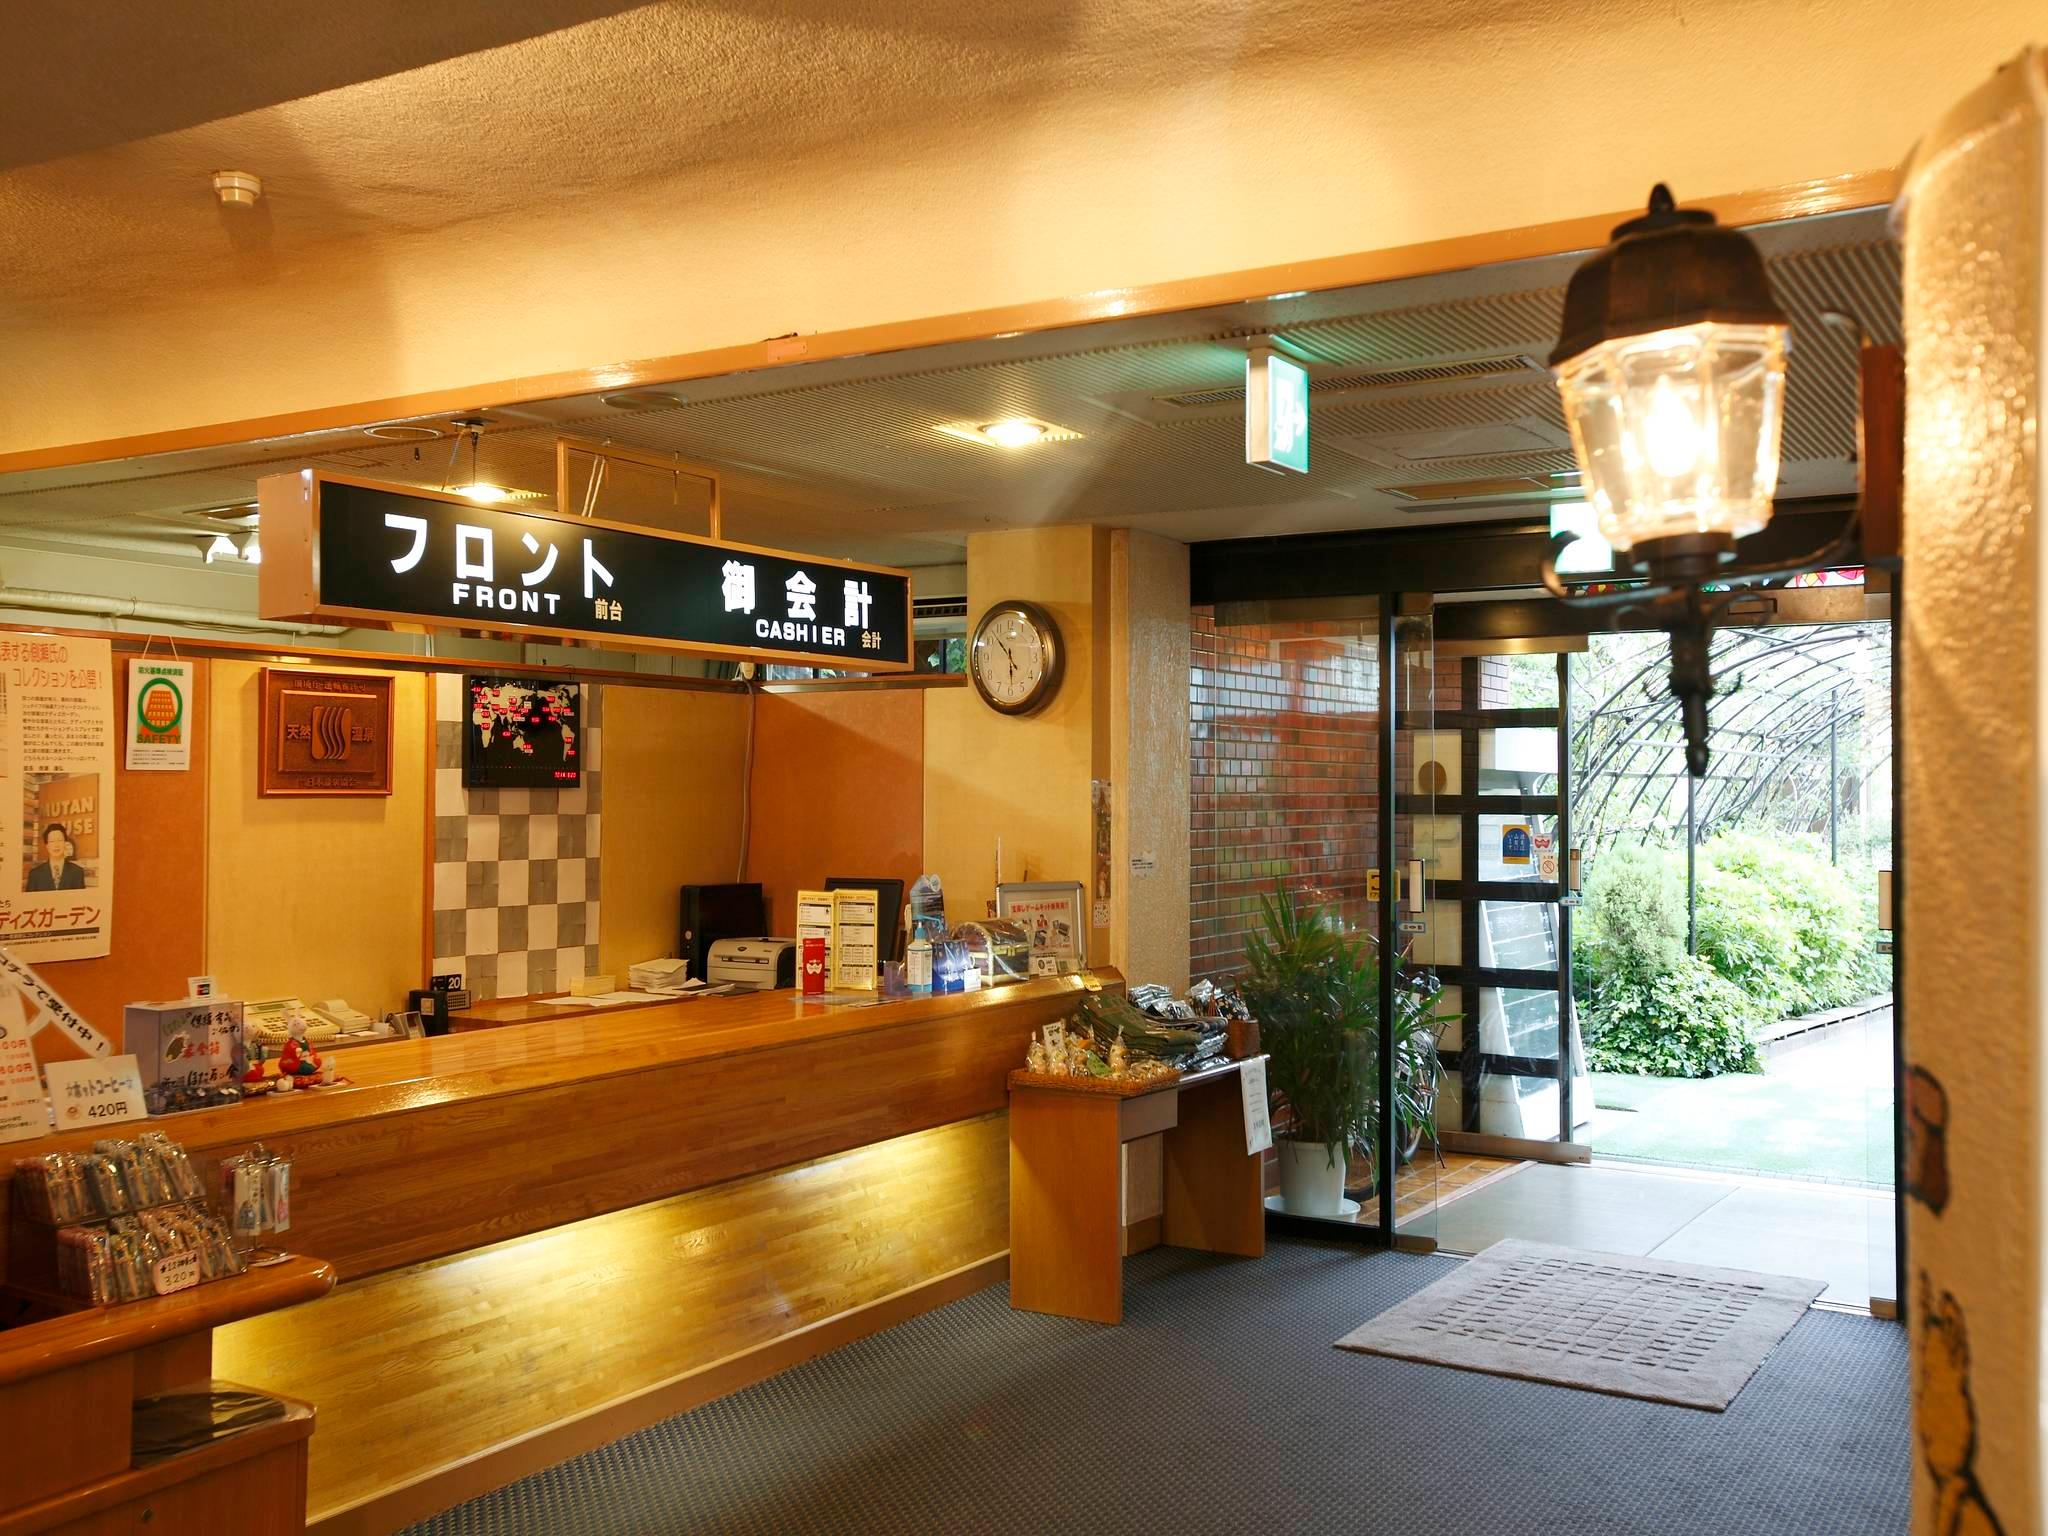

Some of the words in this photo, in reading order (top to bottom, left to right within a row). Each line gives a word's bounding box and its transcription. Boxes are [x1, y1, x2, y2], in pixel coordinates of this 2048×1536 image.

[383, 512, 615, 598] フロント
[451, 582, 561, 616] FRONT
[720, 559, 873, 630] 御会計
[594, 598, 623, 622] 前台
[755, 618, 846, 648] CASHIER
[861, 631, 881, 650] 会計
[137, 734, 182, 744] SAFETY
[448, 976, 461, 989] 20
[88, 1102, 128, 1118] 420円
